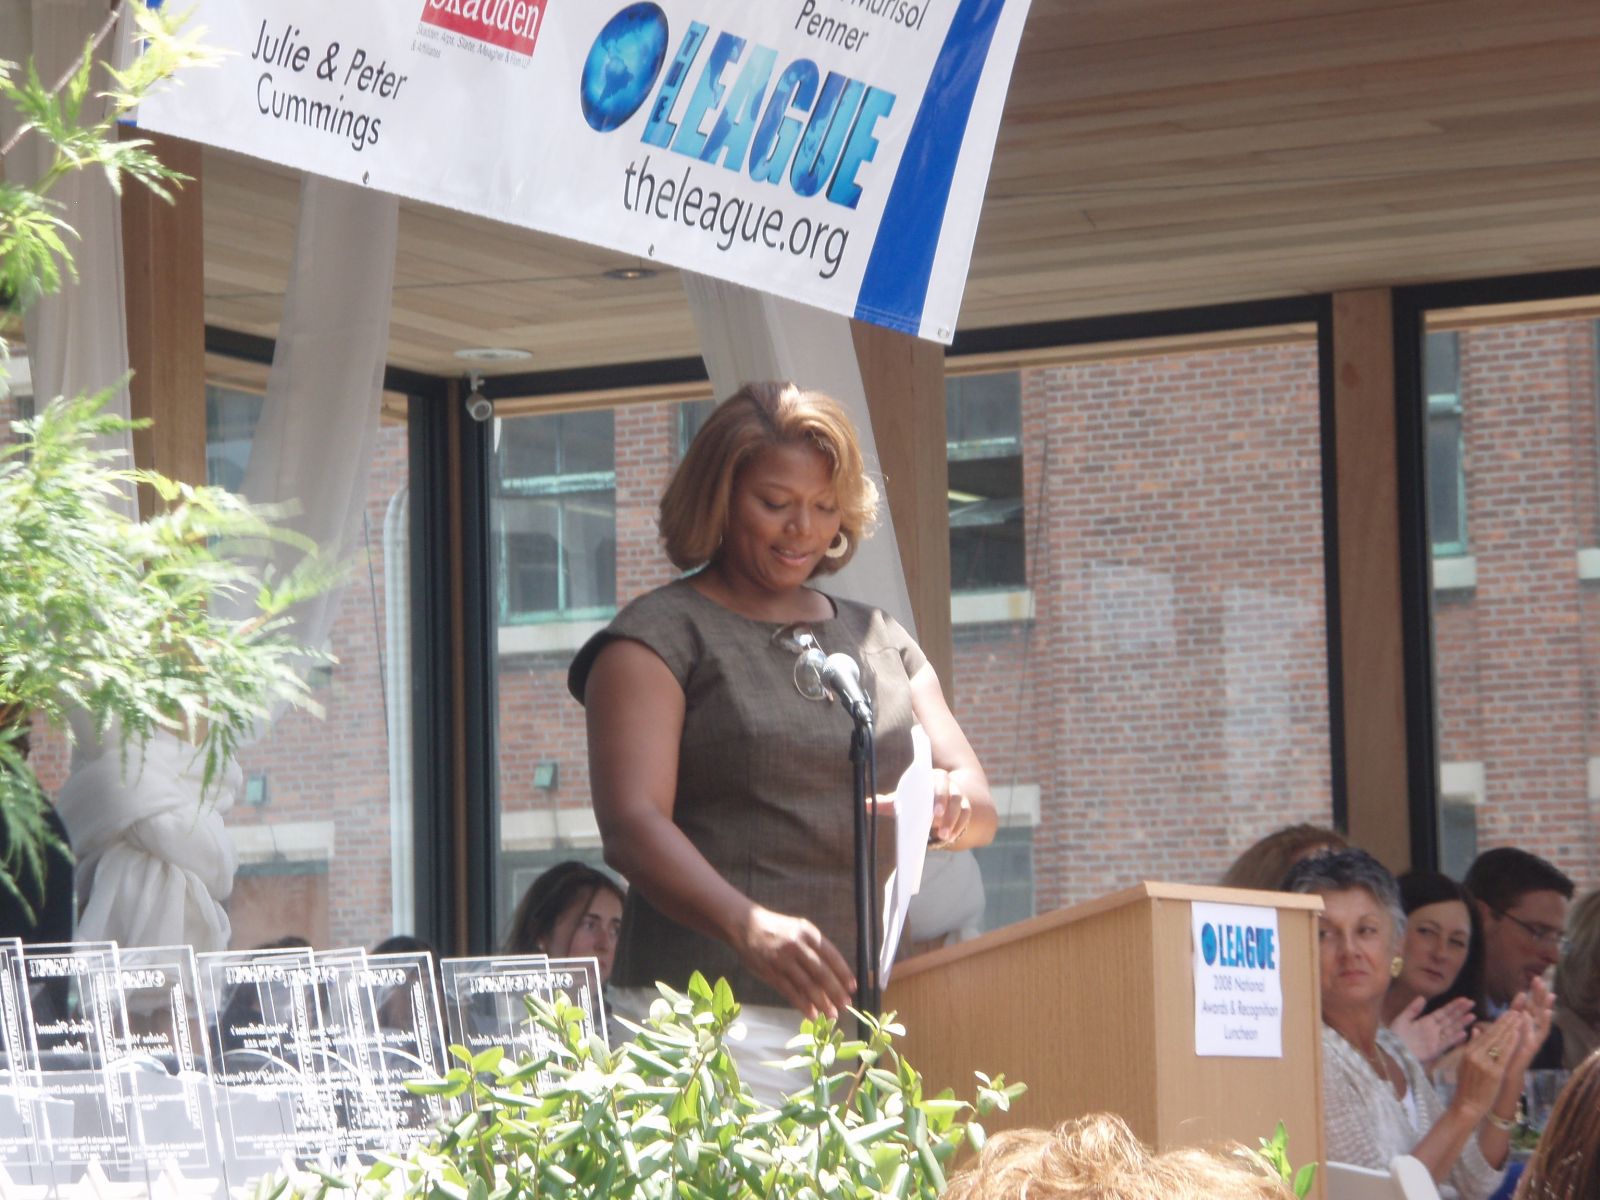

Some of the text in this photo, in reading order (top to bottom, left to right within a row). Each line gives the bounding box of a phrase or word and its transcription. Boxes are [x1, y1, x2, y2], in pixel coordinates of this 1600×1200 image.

[794, 0, 869, 52] Penner
[850, 0, 931, 31] arisol
[251, 19, 408, 100] Julie & Peter
[256, 72, 382, 152] Cummings
[640, 19, 897, 210] LEAGUE
[623, 155, 850, 279] theleague.org
[1217, 924, 1276, 970] LEAGUE
[1201, 999, 1228, 1015] Awards
[1238, 1000, 1279, 1020] Recognition
[1223, 1024, 1259, 1040] Luncheon
